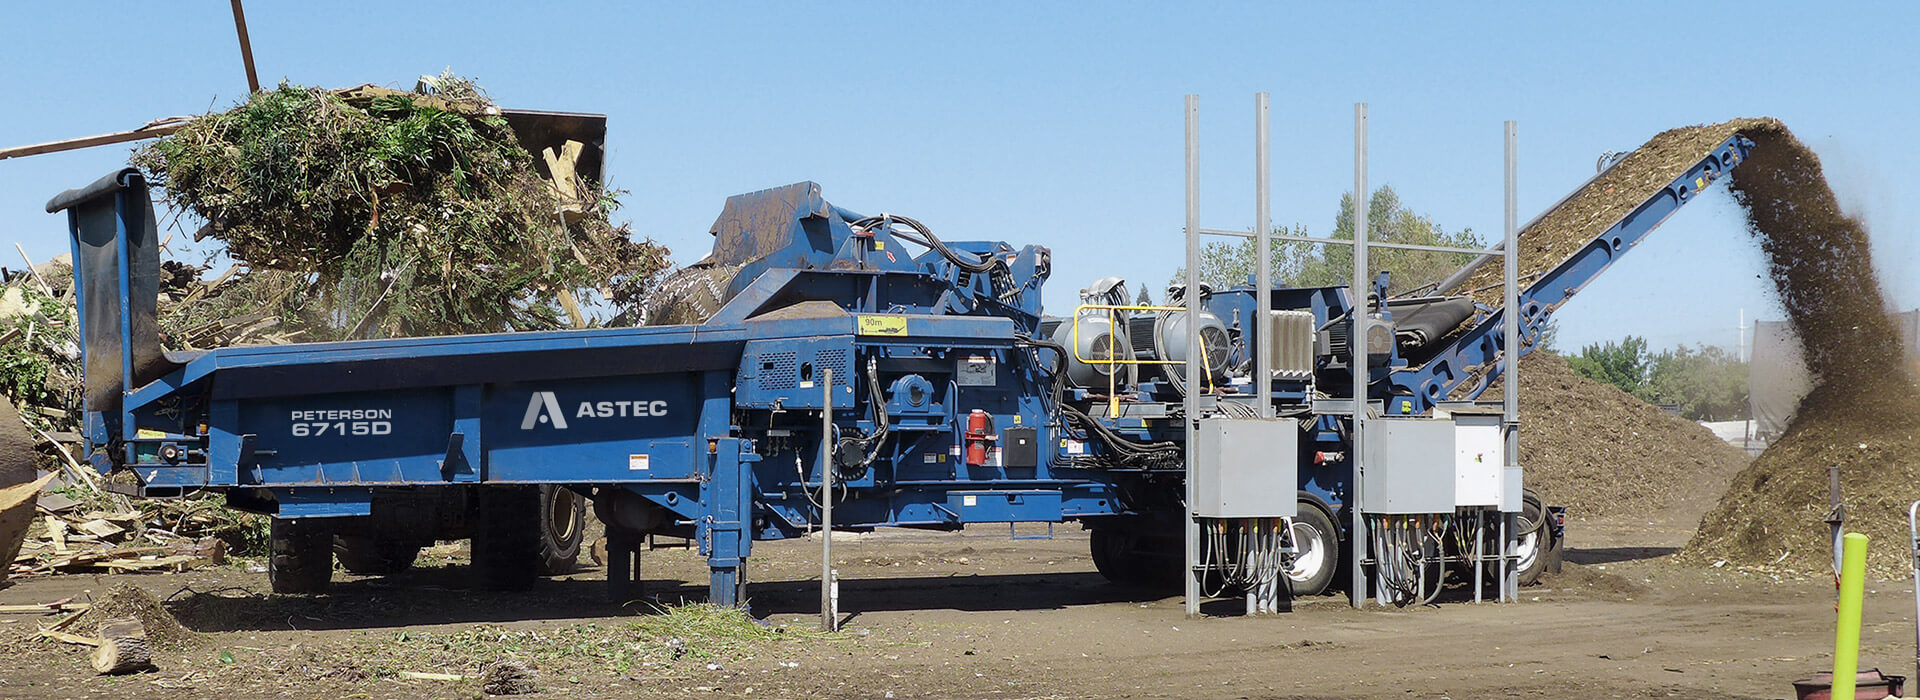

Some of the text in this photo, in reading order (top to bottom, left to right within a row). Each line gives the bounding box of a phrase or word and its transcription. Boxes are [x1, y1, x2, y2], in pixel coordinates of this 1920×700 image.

[865, 318, 883, 326] 90m
[291, 409, 392, 421] PETERSON
[576, 400, 668, 418] ASTEC
[292, 421, 392, 437] 6715D
